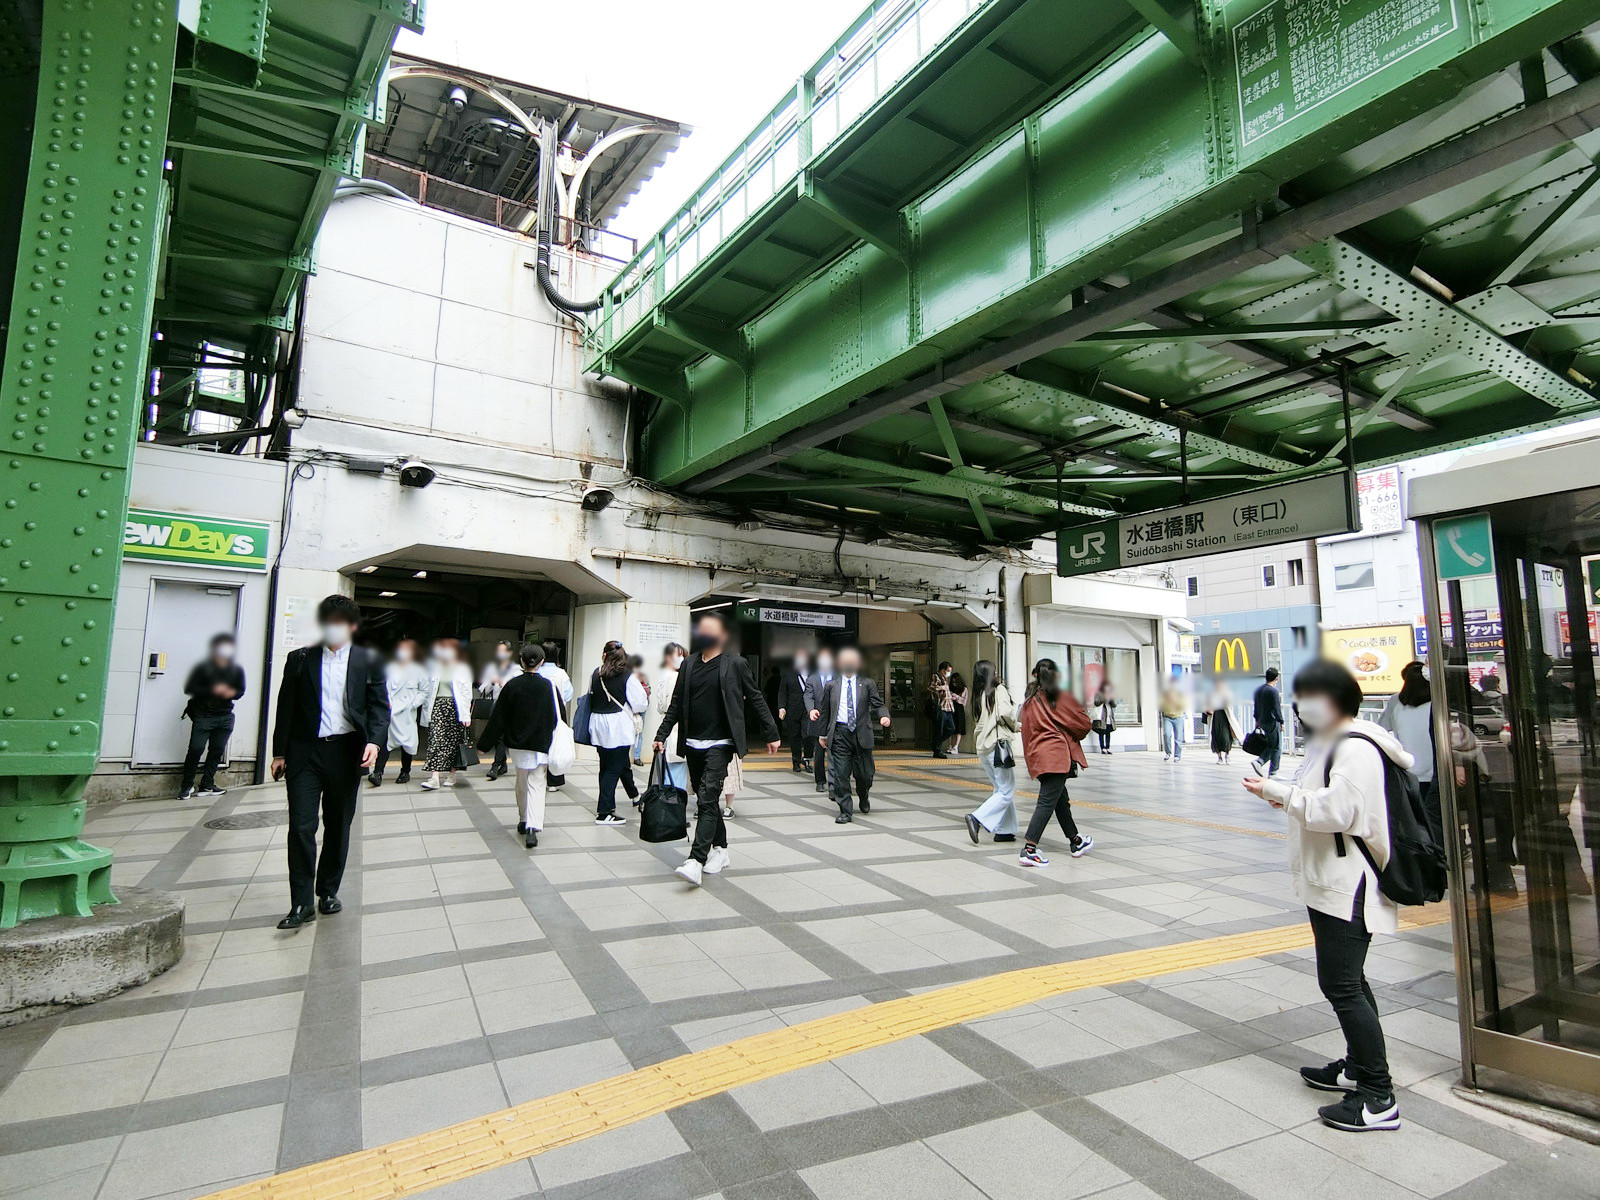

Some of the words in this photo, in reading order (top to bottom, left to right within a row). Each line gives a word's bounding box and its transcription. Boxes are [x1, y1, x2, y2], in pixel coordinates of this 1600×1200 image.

[124, 521, 255, 555] ewDays
[1126, 512, 1204, 545] 水道橋駅
[1127, 541, 1183, 558] Suidōbashi
[1186, 535, 1226, 549] Station
[1233, 532, 1255, 541] (East
[1257, 523, 1299, 538] Entrance)
[1070, 531, 1106, 559] JR
[1074, 557, 1103, 567] JR東日本
[743, 608, 756, 616] JR
[764, 609, 799, 622] 水道橋駅
